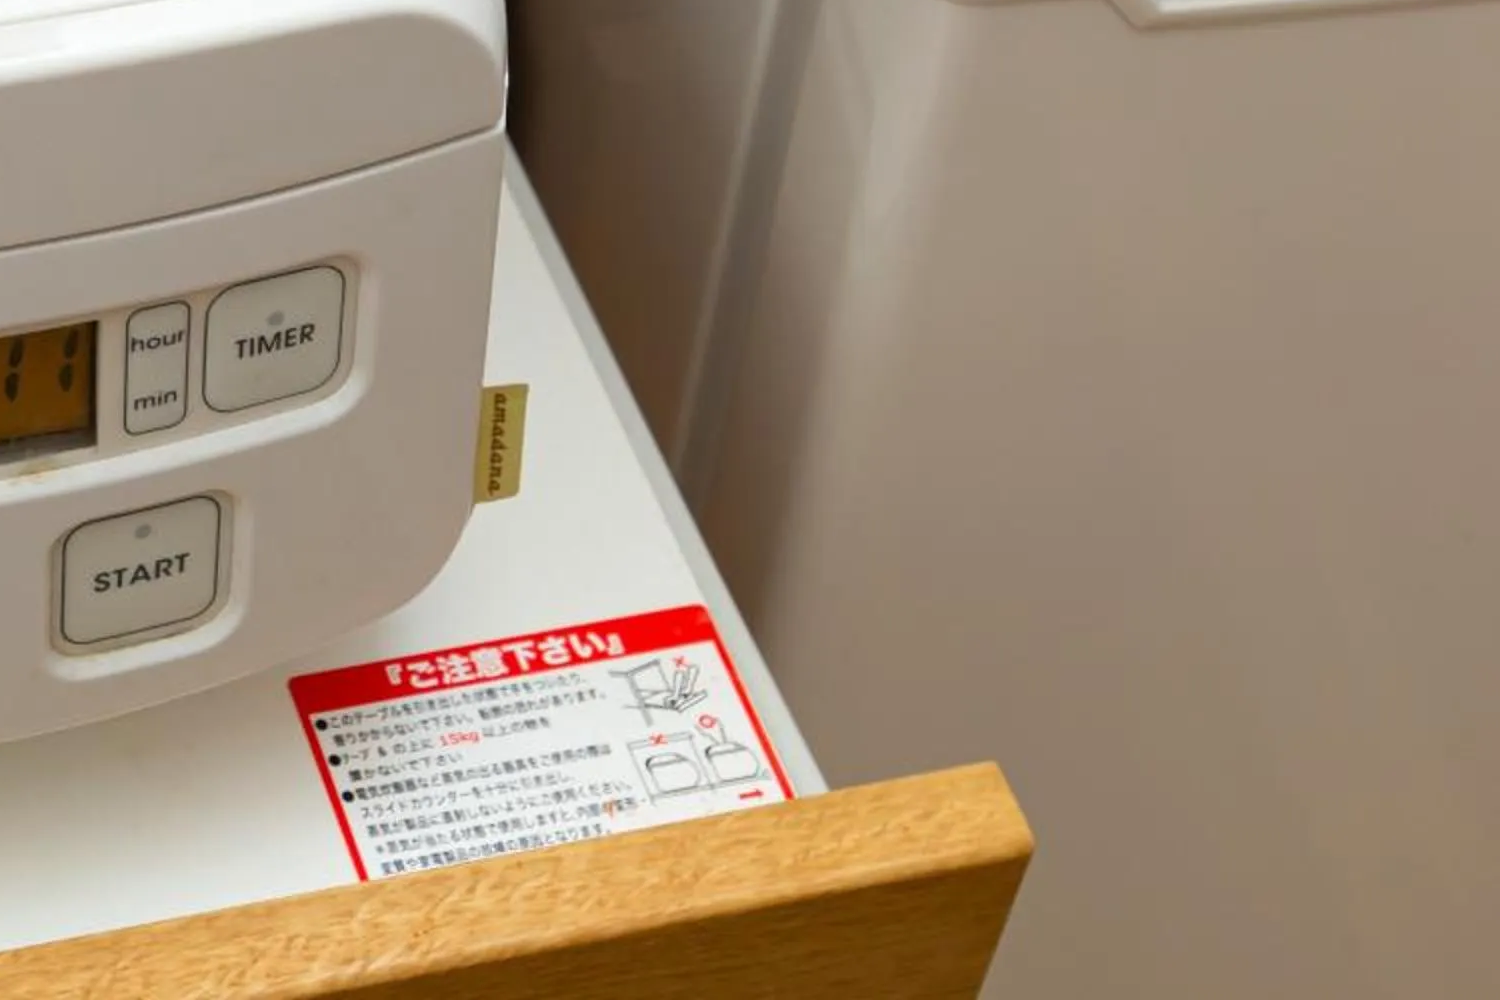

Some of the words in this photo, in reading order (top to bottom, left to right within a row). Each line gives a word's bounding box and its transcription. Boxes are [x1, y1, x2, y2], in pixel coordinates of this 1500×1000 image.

[130, 329, 185, 353] hour
[234, 323, 316, 360] TIMER
[134, 390, 177, 411] min
[488, 392, 508, 497] amadana
[93, 552, 190, 593] START
